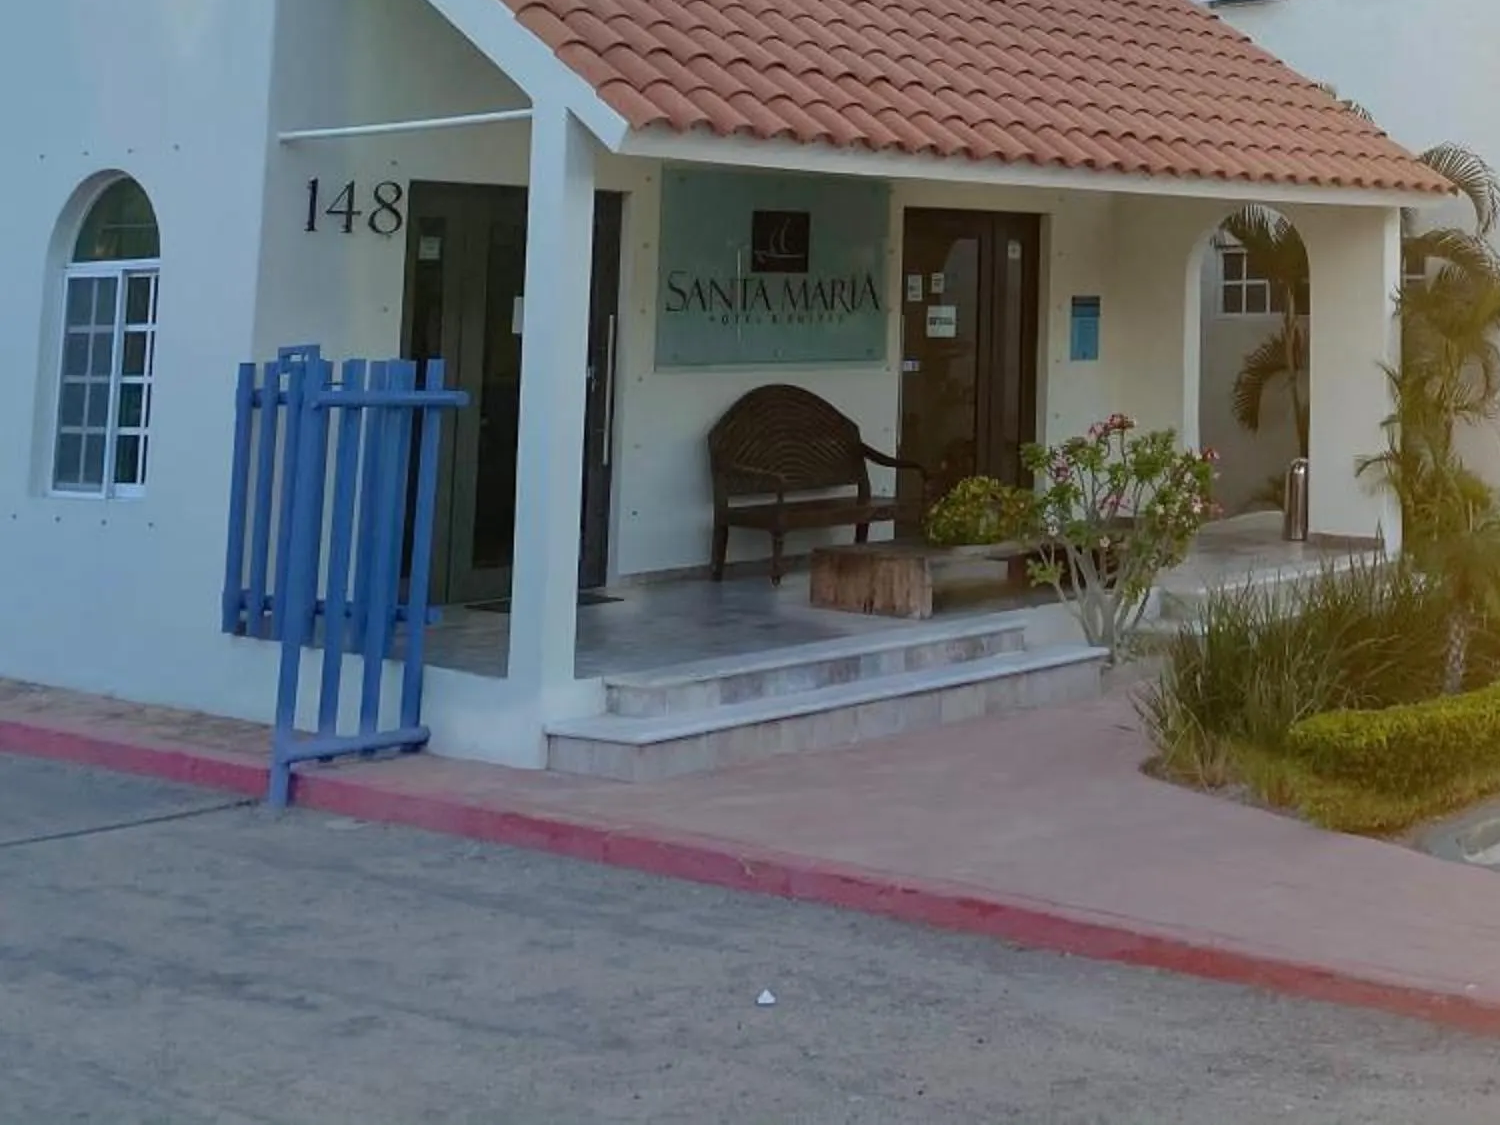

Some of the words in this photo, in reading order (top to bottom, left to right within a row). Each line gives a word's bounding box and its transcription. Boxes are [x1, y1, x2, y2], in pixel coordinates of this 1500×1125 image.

[303, 177, 403, 235] 148
[665, 271, 771, 312] SANTA
[782, 273, 880, 313] MARIA
